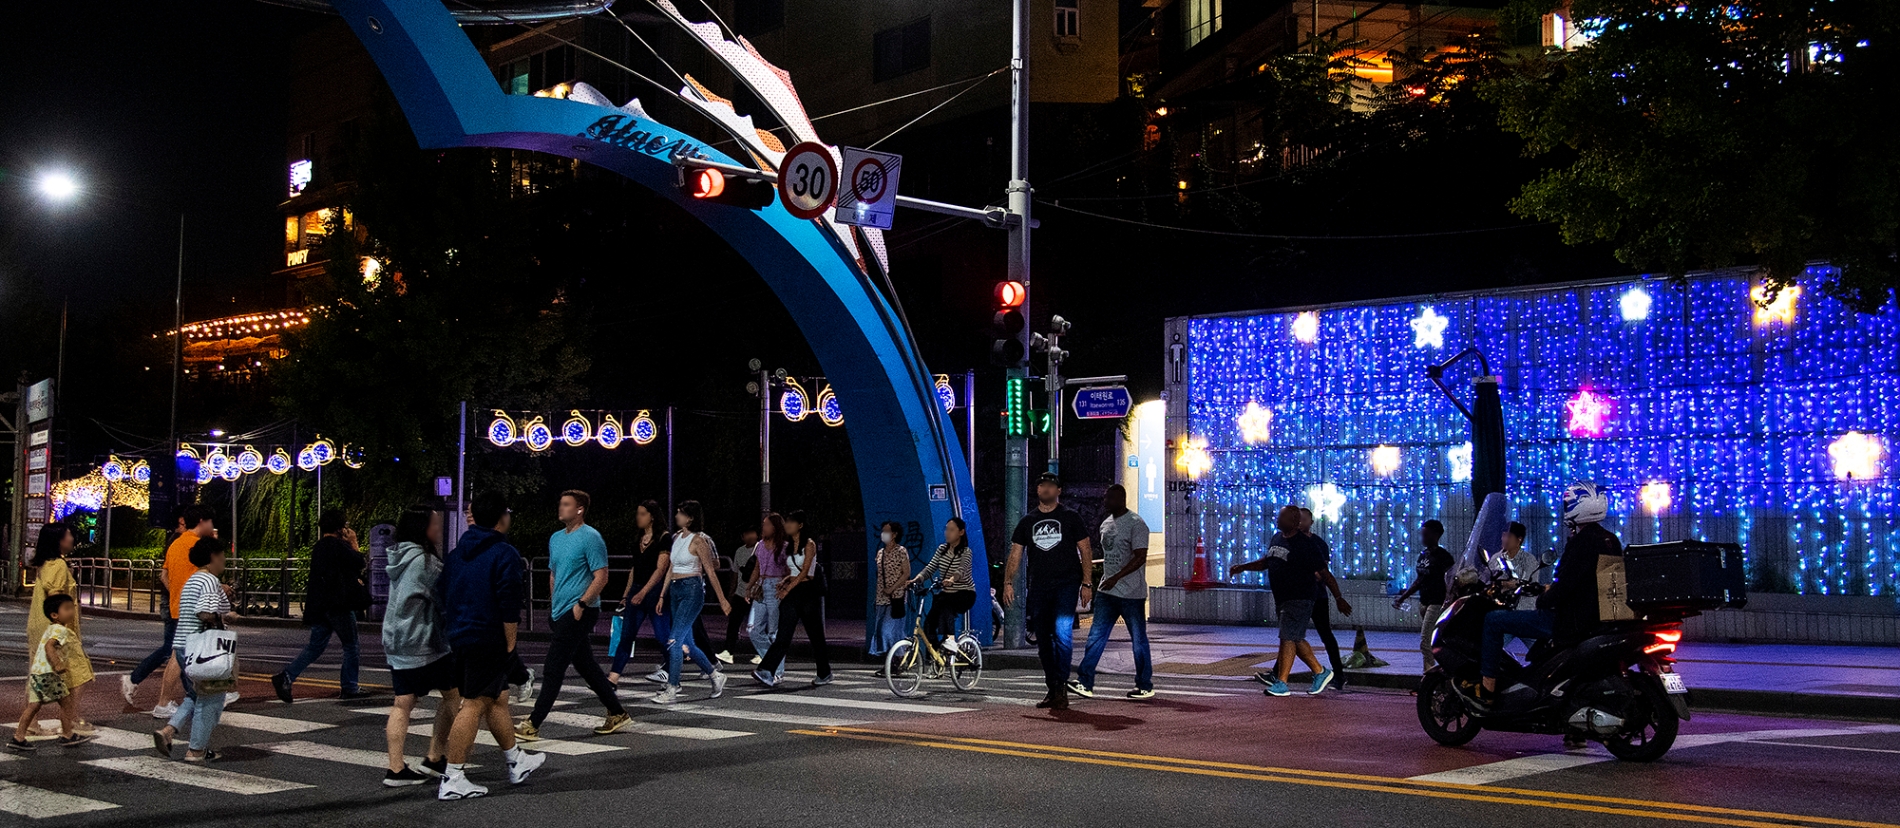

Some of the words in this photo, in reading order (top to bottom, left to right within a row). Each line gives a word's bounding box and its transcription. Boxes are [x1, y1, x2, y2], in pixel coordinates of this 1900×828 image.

[793, 163, 825, 200] 30
[861, 170, 880, 193] 50
[1090, 391, 1114, 401] 이태원로
[1078, 400, 1087, 408] 131
[1116, 398, 1126, 406] 135
